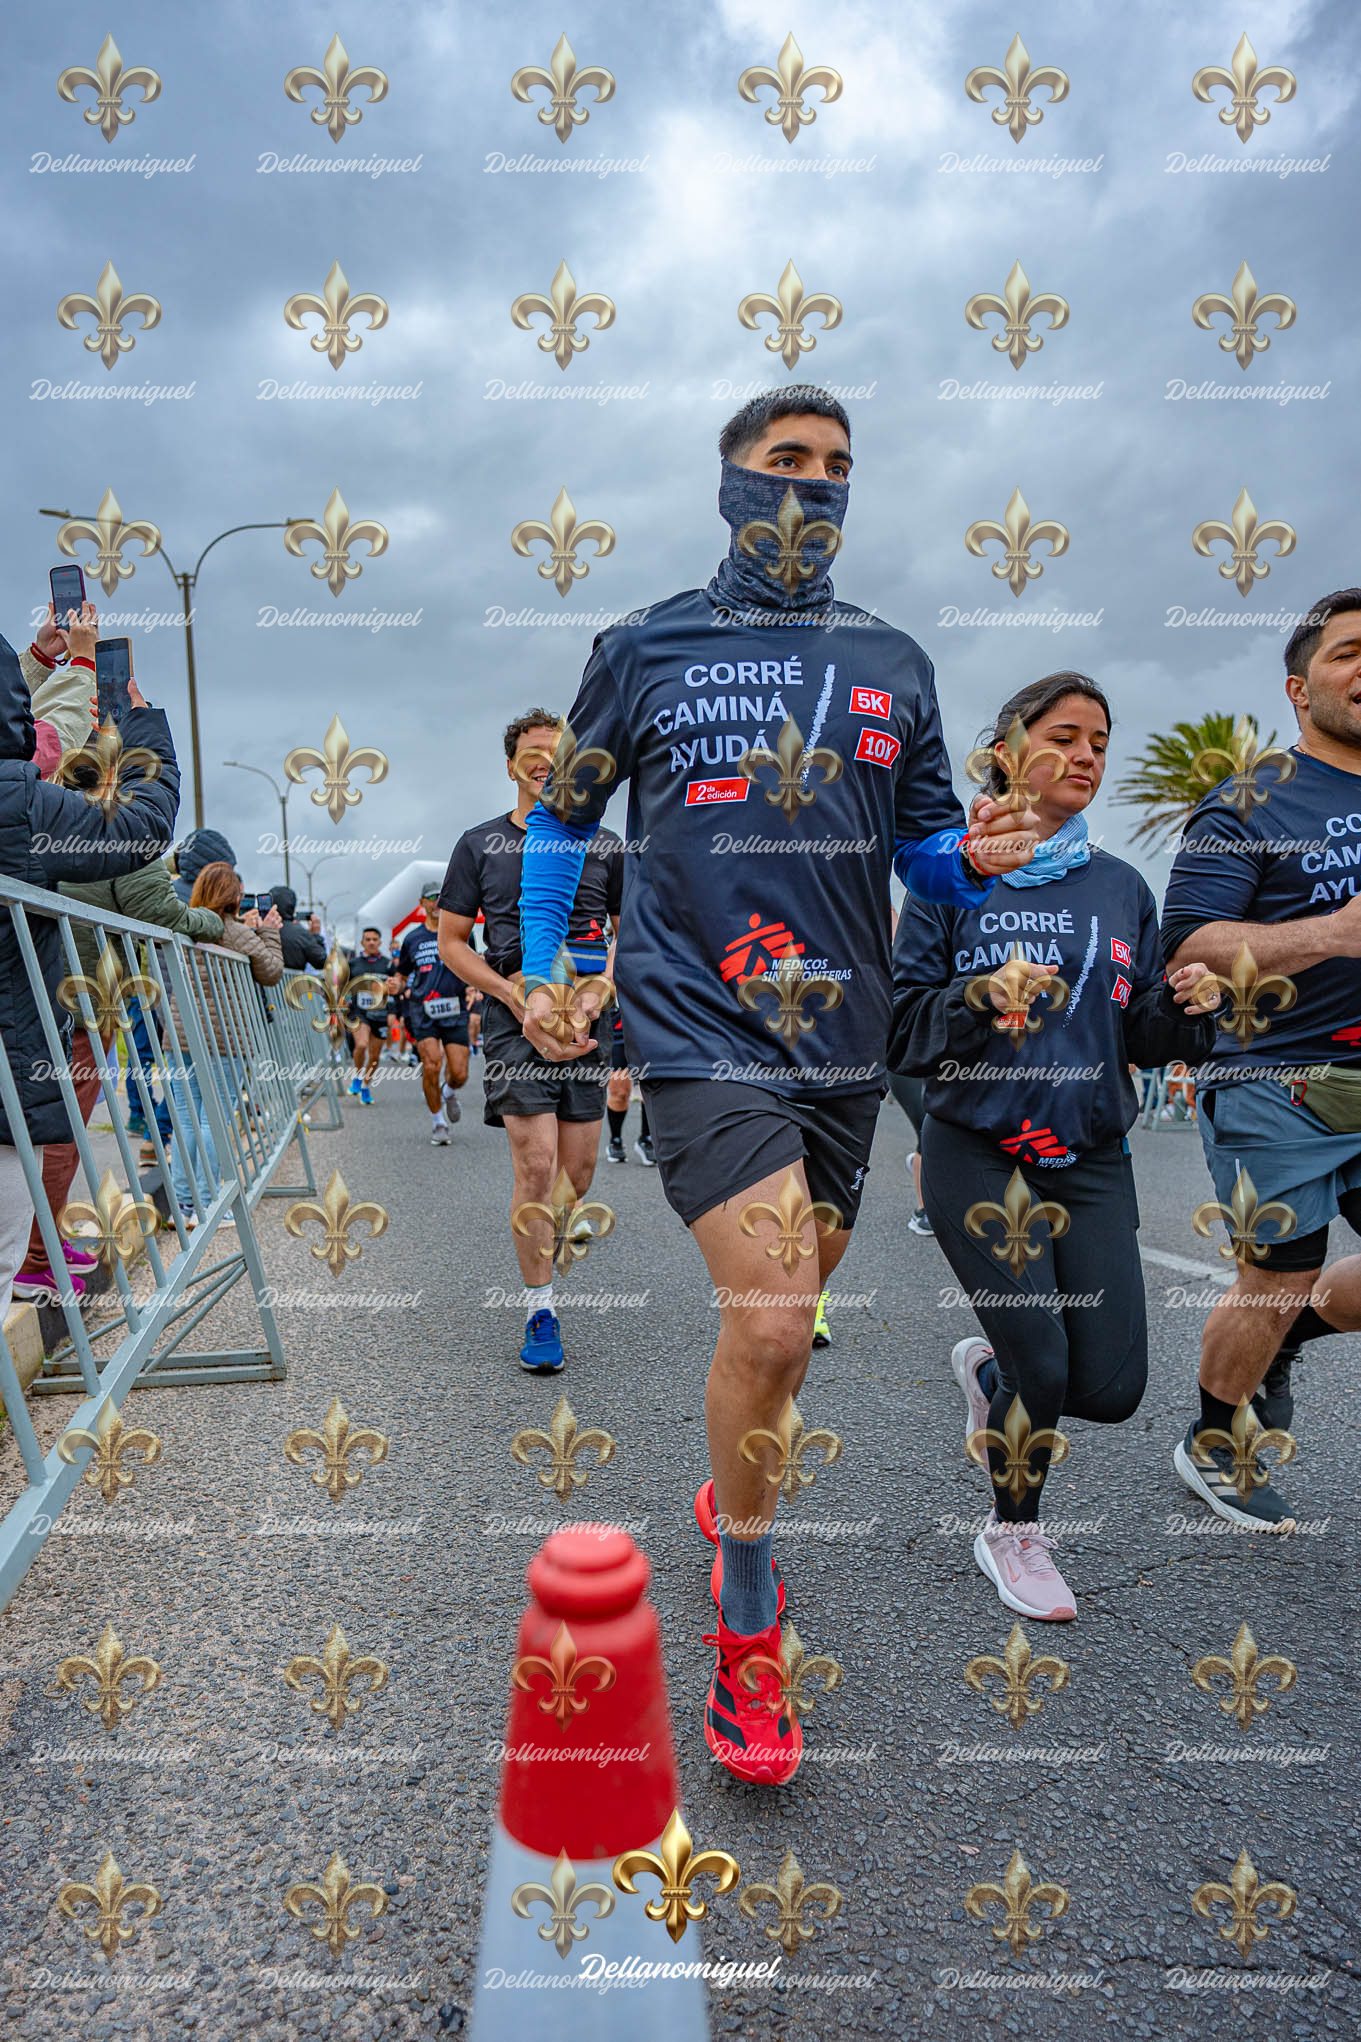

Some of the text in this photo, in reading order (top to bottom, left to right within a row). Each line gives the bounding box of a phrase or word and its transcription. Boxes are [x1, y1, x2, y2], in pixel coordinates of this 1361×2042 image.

[684, 656, 804, 688] CORRÉ
[653, 691, 792, 736] CAMINÁ
[857, 692, 886, 714] 5K
[670, 729, 775, 773] AYUDÁ
[707, 789, 737, 800] edición
[979, 909, 1074, 934] CORRÉ
[771, 958, 829, 970] MEDICOS
[954, 939, 1064, 972] CAMINÁ
[1115, 943, 1129, 963] 5K
[762, 969, 852, 982] SIN FRONTERAS
